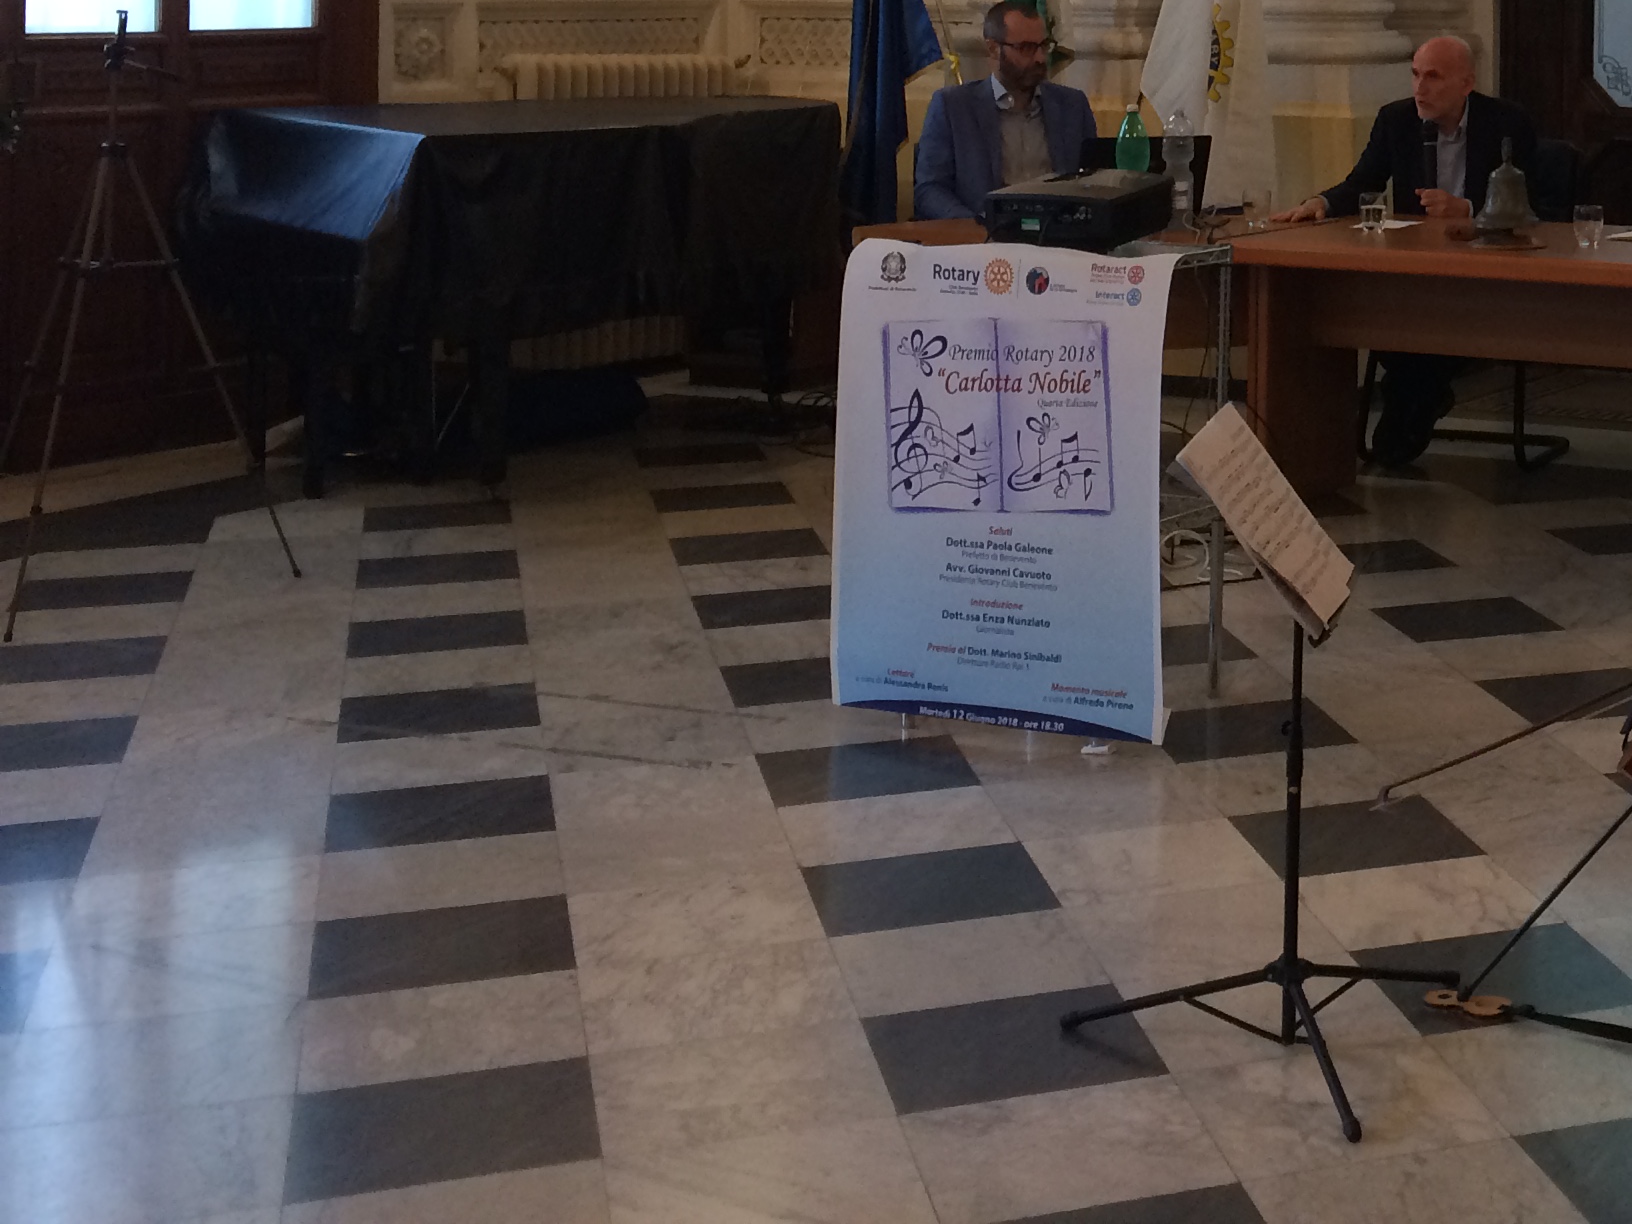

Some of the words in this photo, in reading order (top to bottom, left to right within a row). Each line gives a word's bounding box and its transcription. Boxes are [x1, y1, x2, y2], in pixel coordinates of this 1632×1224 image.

[933, 263, 981, 286] Rotary
[1091, 263, 1127, 275] Rotaract
[1004, 344, 1054, 368] Rotary
[1059, 344, 1096, 363] 2018
[989, 526, 1013, 536] Saluti
[946, 537, 985, 551] Dott.ssa
[986, 540, 1012, 552] Paola
[1015, 543, 1054, 556] Galeone
[968, 564, 1011, 577] Giovanni
[1013, 568, 1052, 581] Cavuoto
[970, 598, 1024, 611] Introduzione
[942, 610, 980, 623] Dott.ssa
[982, 613, 1005, 625] Enza
[1007, 615, 1051, 629] Nunziato
[991, 648, 1022, 660] Marino
[1023, 651, 1062, 664] Sinibaldi
[1073, 696, 1105, 709] Alfredo
[952, 708, 965, 720] 12
[997, 715, 1018, 727] 2018
[1023, 720, 1039, 730] ore
[1040, 720, 1065, 733] 18.30
